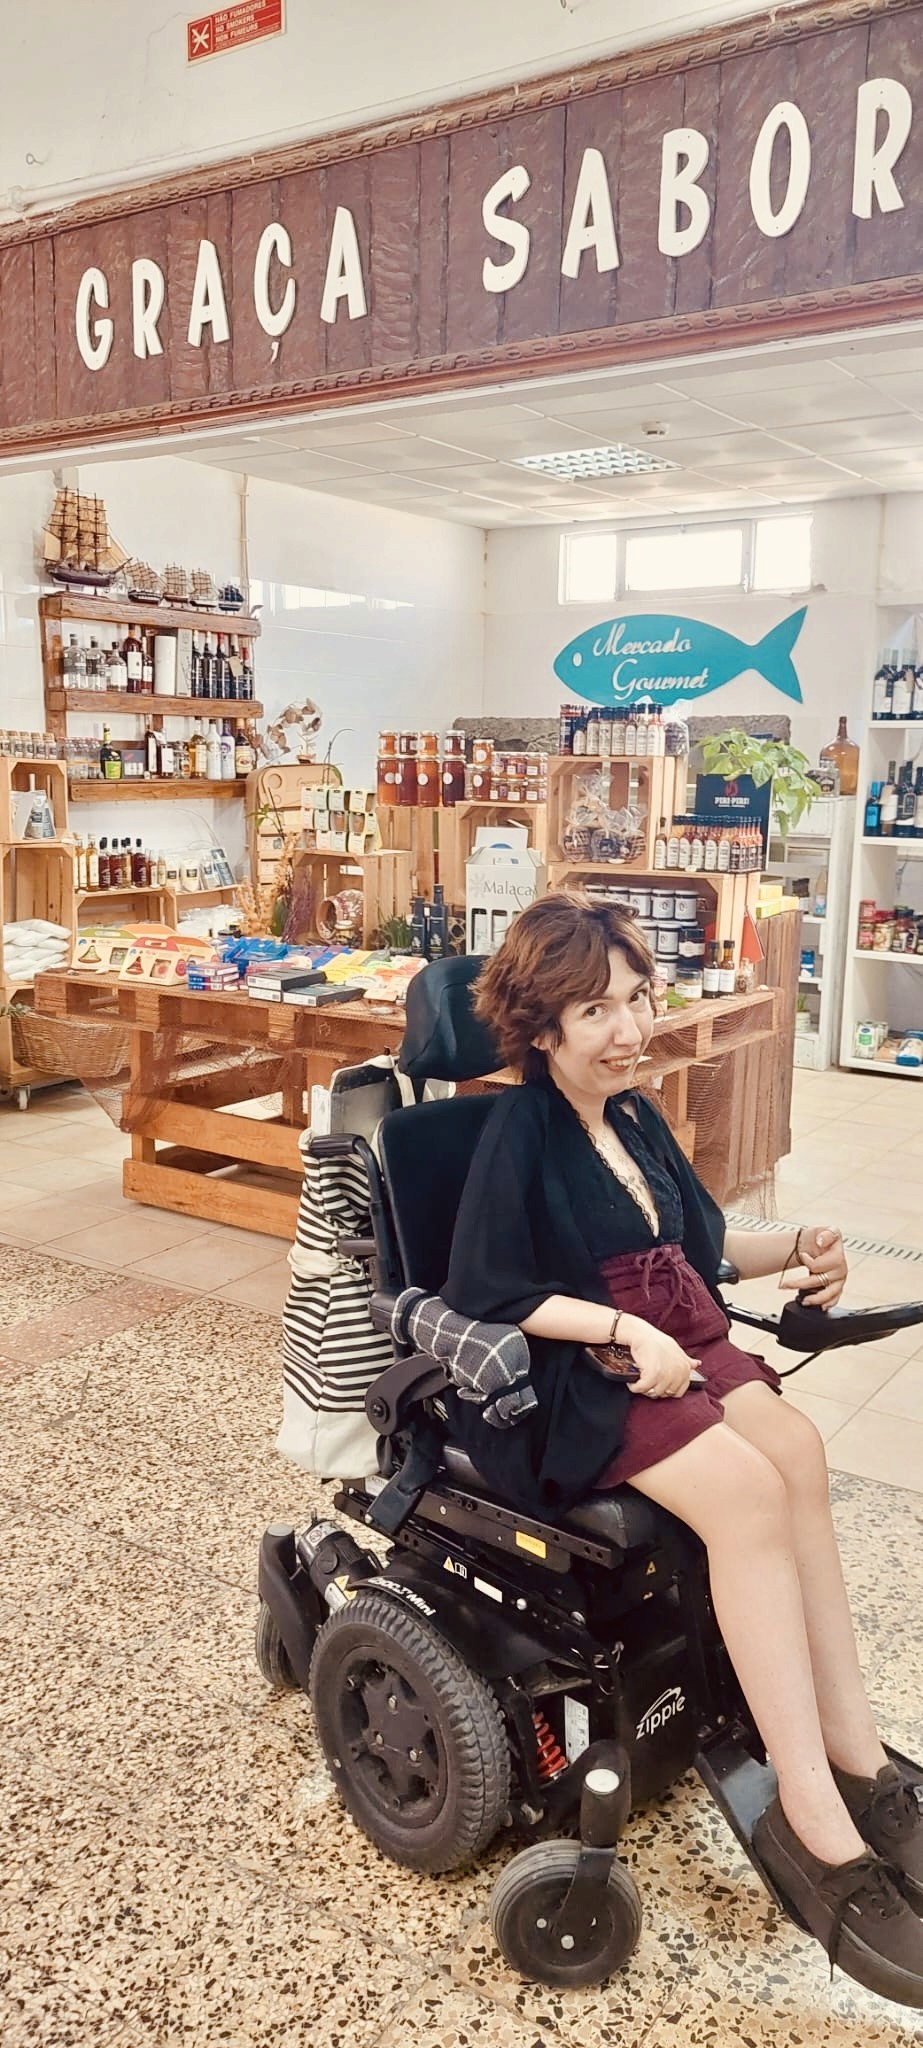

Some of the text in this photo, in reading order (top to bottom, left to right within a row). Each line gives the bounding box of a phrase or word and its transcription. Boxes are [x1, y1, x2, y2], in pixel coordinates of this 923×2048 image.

[215, 14, 255, 33] NO SMOKERS
[230, 22, 258, 38] FUMEURS
[76, 78, 912, 371] GRAÇA SABOR
[593, 622, 692, 656] Mercado
[612, 658, 709, 700] Gourmet
[406, 1594, 436, 1616] Mini
[636, 1696, 686, 1740] zippie
